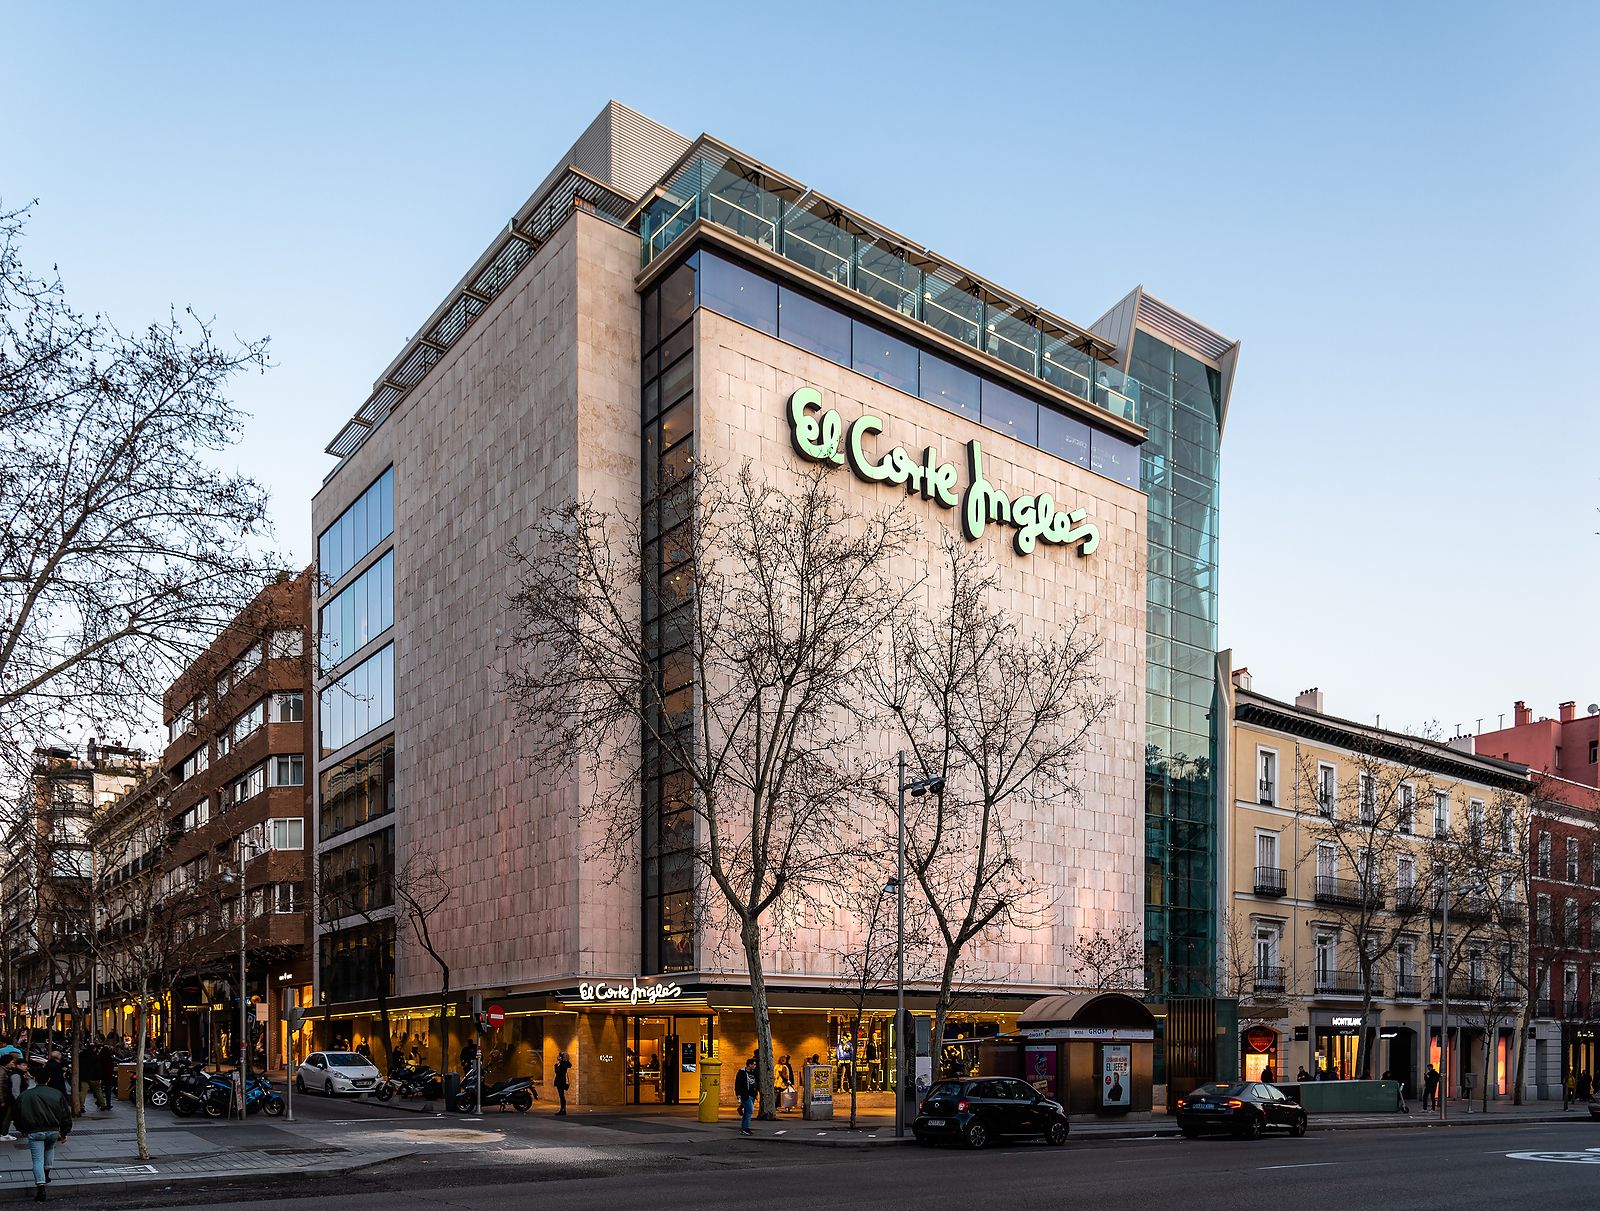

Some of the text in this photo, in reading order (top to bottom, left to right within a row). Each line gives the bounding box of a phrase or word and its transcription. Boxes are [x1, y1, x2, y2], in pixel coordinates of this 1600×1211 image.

[787, 387, 1100, 557] El Corte Inglés
[579, 977, 682, 1005] El Corte Inglés
